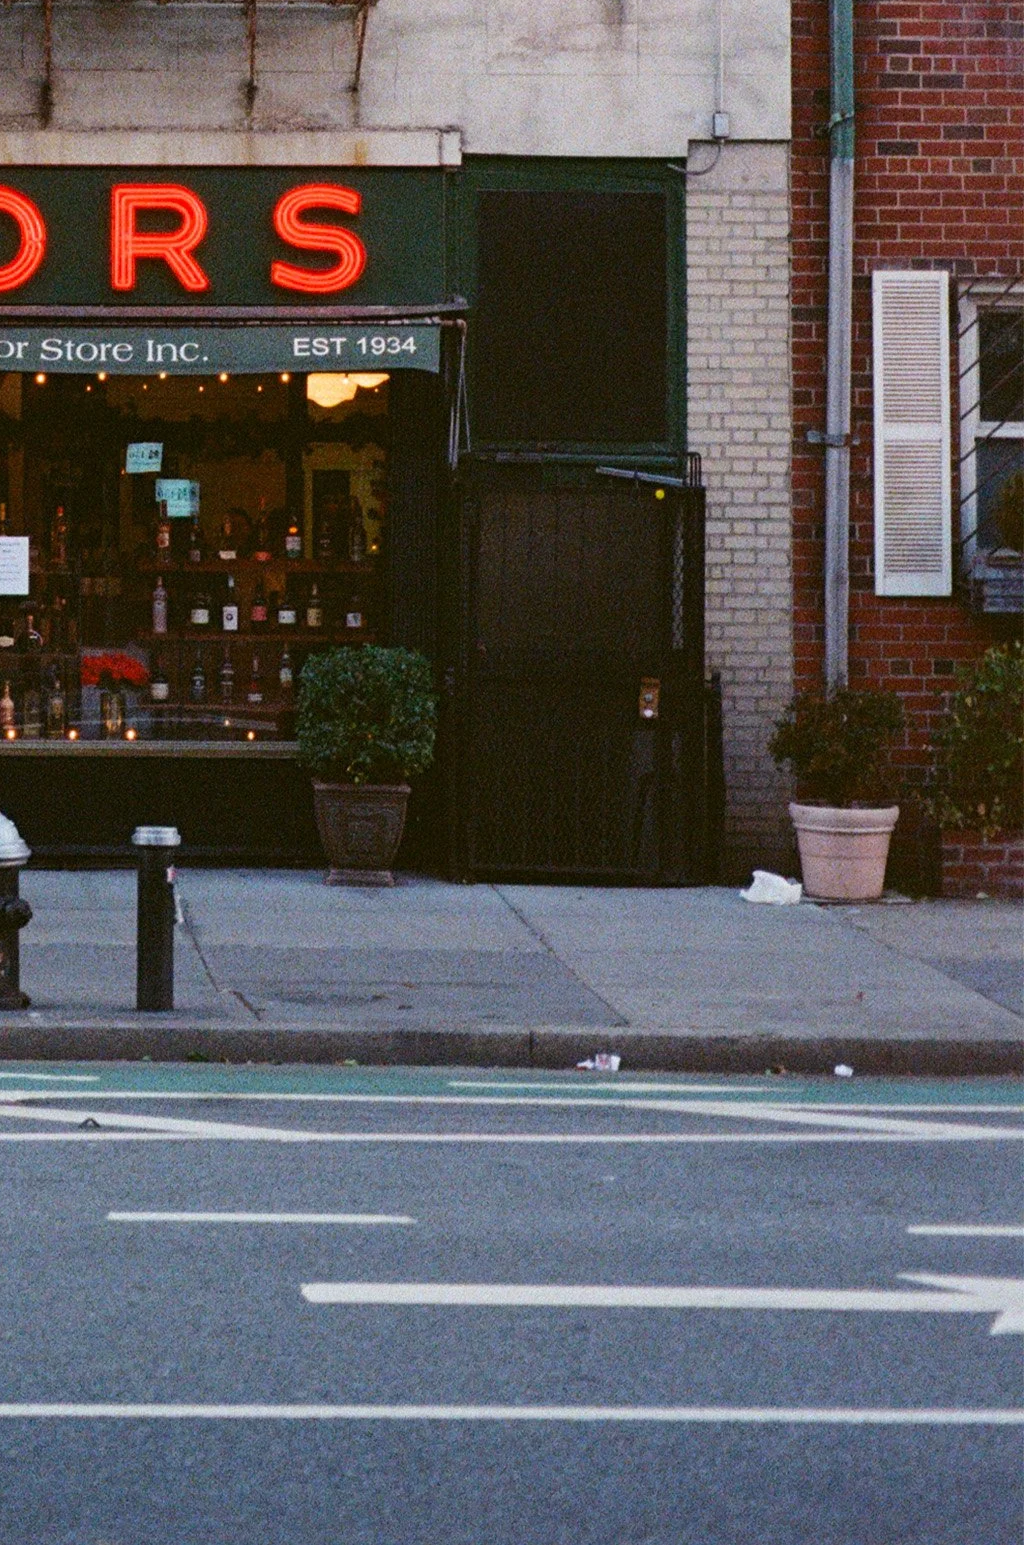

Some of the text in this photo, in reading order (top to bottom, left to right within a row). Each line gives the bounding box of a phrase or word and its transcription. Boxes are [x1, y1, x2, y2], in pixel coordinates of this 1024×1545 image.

[40, 338, 134, 361] Store
[146, 340, 209, 362] Inc.
[293, 336, 417, 356] EST 1934
